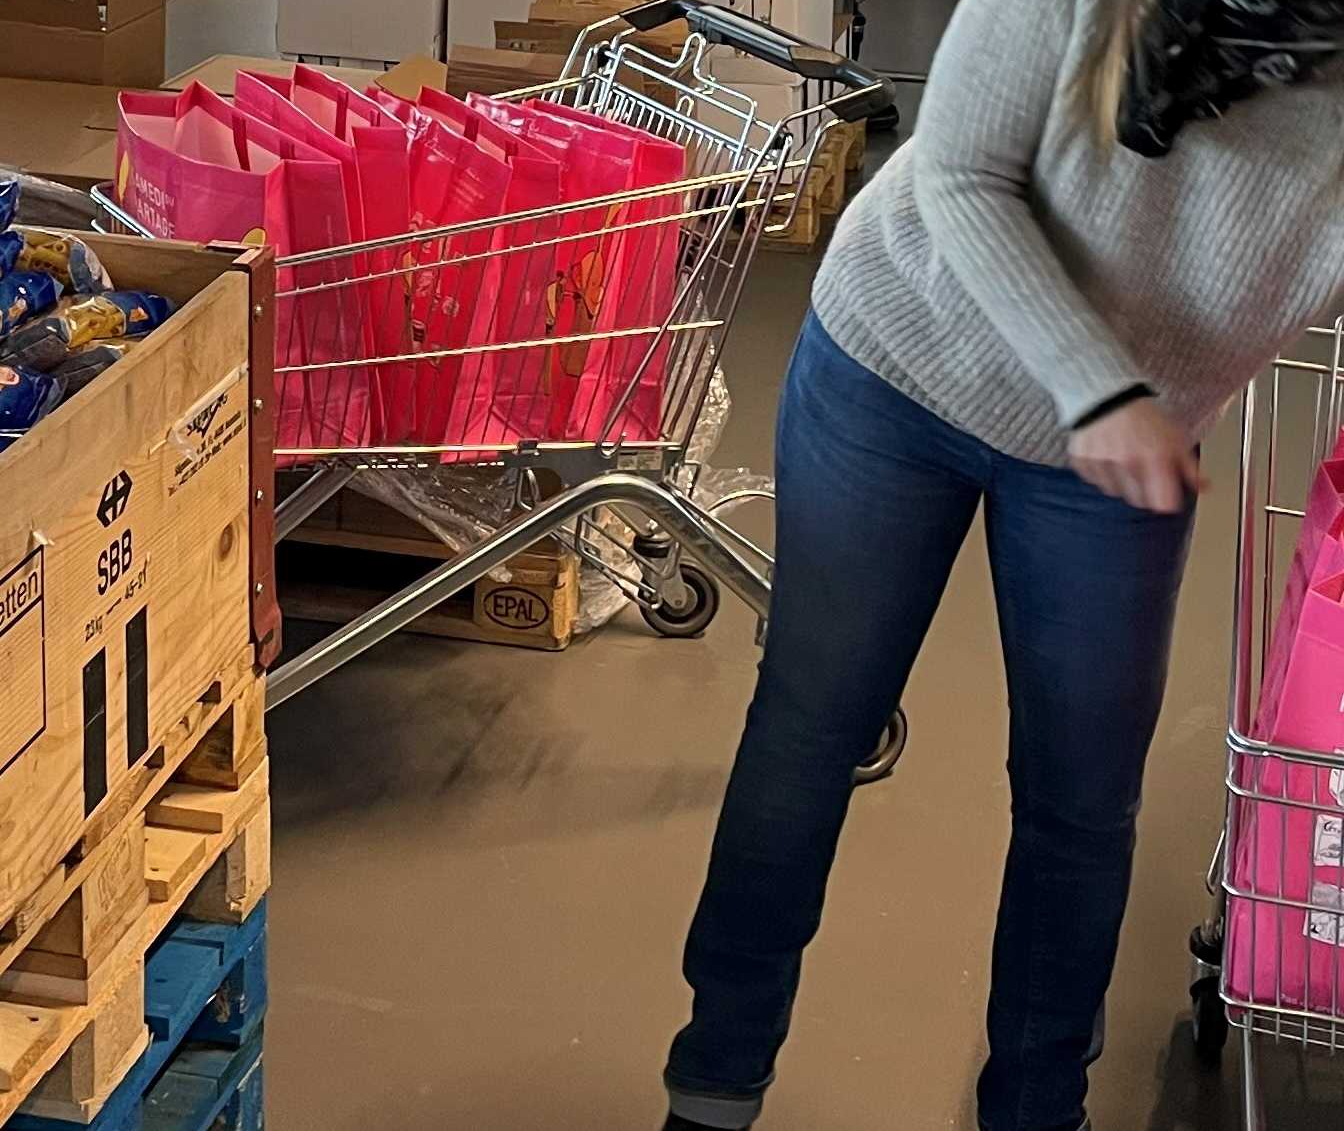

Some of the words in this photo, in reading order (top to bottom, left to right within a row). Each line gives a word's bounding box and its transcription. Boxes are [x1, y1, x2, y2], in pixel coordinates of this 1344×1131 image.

[136, 197, 175, 240] ARTAGE
[97, 528, 132, 596] SBB
[493, 594, 538, 622] EPAL
